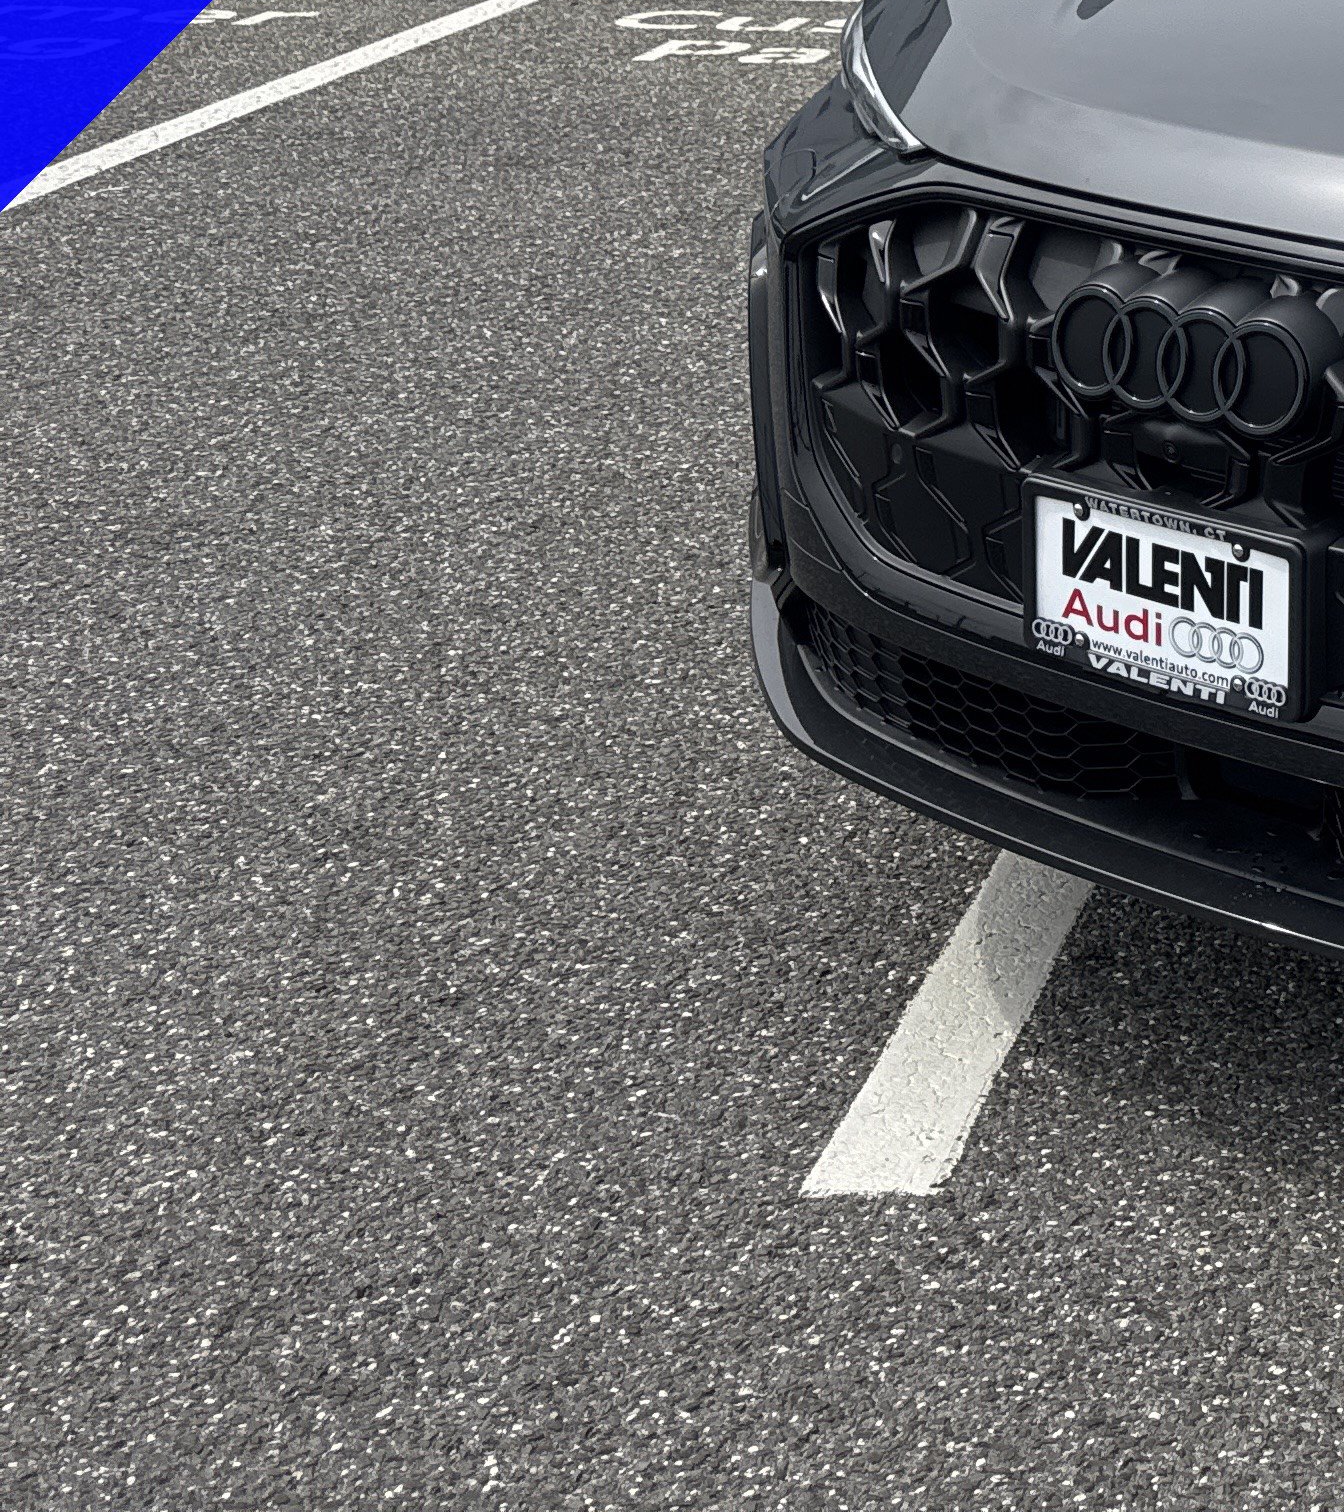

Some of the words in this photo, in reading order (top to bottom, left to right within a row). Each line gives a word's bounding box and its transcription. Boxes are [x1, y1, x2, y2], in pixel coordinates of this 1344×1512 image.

[1204, 526, 1226, 542] CT
[1062, 516, 1264, 631] VALENTI
[1061, 587, 1163, 647] Audi
[1036, 639, 1065, 657] Audi
[1091, 638, 1229, 688] www.valentiauto.com
[1087, 652, 1227, 705] VALENTI
[1248, 701, 1279, 719] Audi
